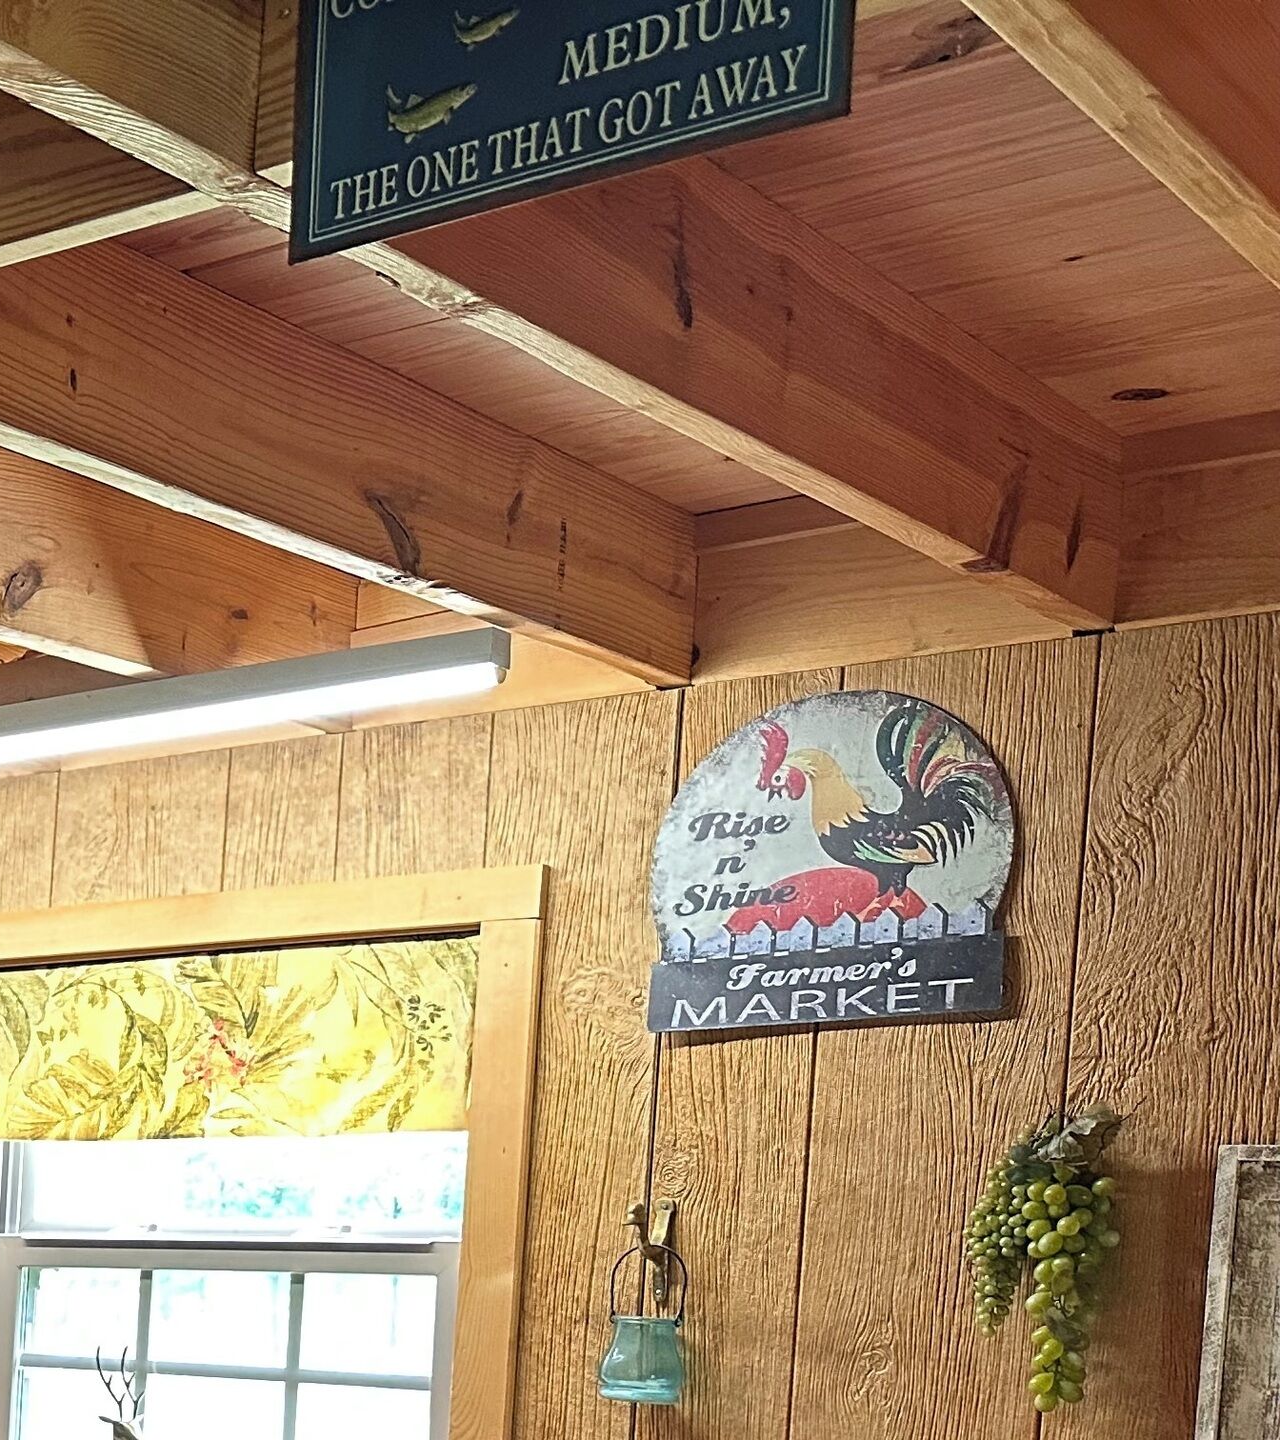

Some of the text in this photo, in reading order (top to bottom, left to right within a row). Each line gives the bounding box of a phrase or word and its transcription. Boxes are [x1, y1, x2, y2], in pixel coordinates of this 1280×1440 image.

[558, 0, 790, 85] MEDIUM,
[330, 44, 807, 219] THE ONE THAT GOT AWAY
[688, 812, 791, 842] Rise
[674, 882, 799, 917] Shine
[726, 948, 918, 991] Farmer's
[670, 978, 974, 1029] MARKET
